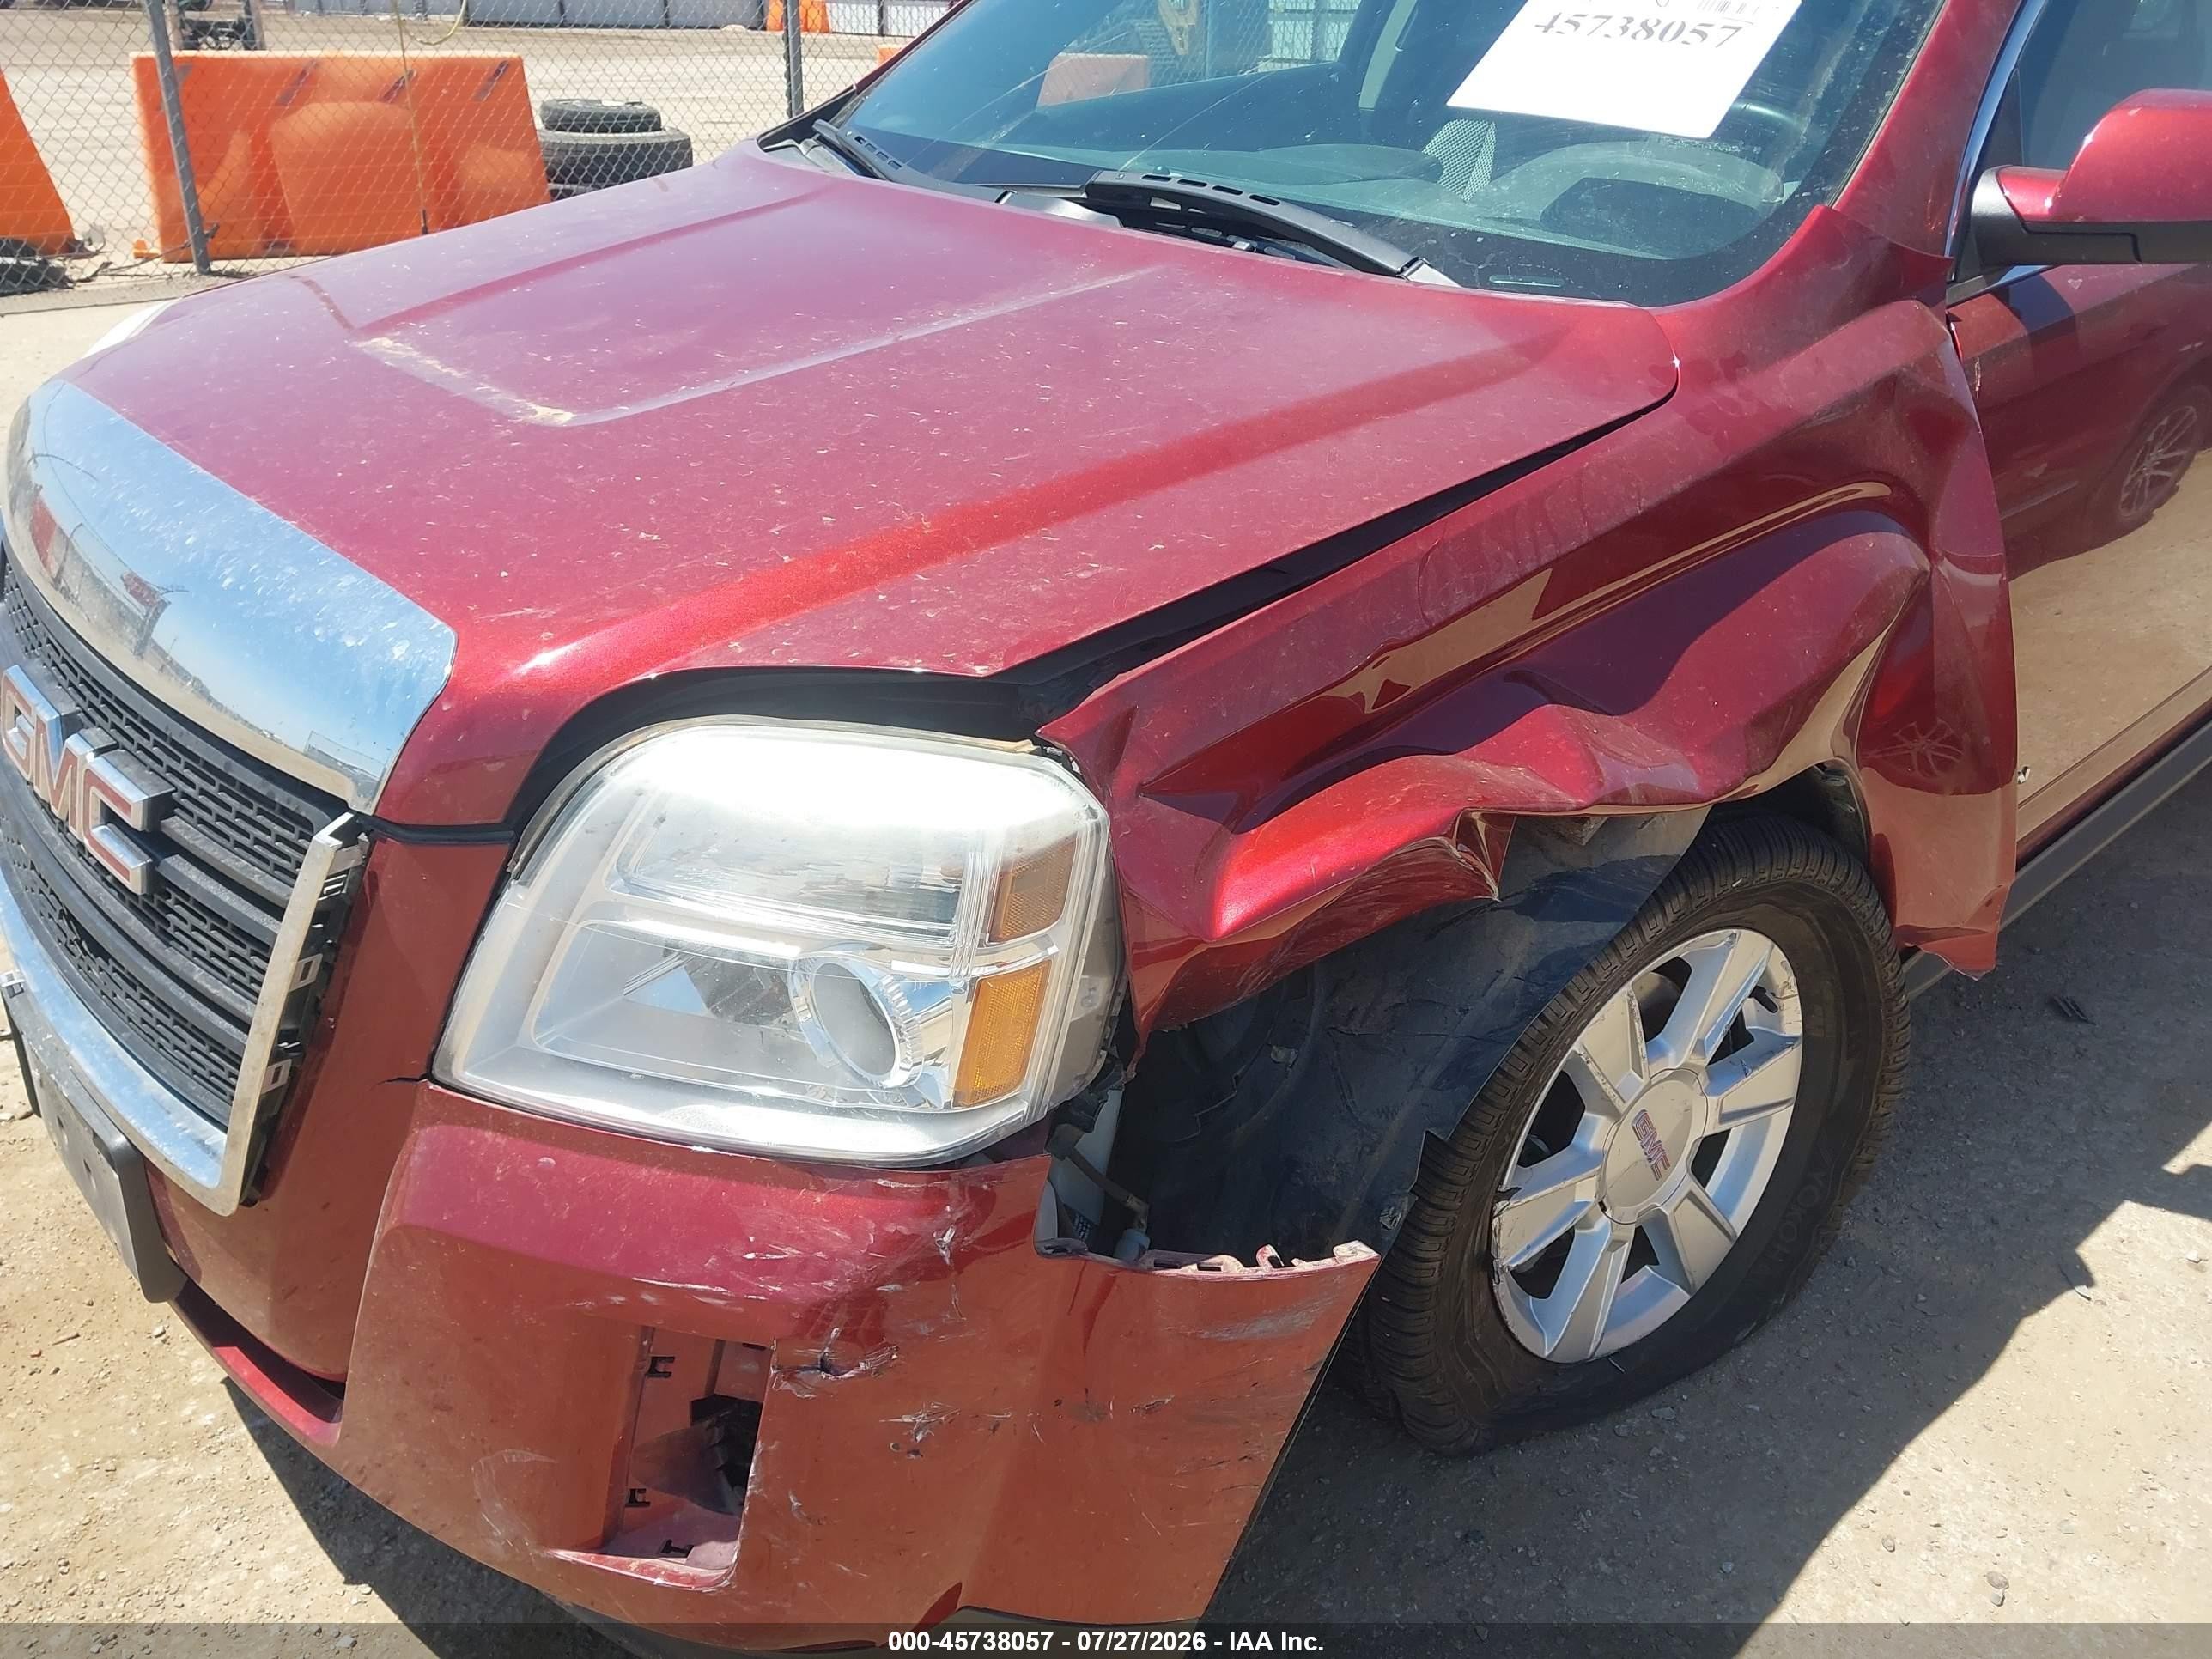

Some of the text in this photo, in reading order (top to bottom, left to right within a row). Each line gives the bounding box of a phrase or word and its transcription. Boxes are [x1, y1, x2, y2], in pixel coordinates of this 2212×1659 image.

[1534, 12, 1743, 48] 45738057
[1, 665, 153, 896] GMC
[1632, 1109, 1670, 1181] GMC
